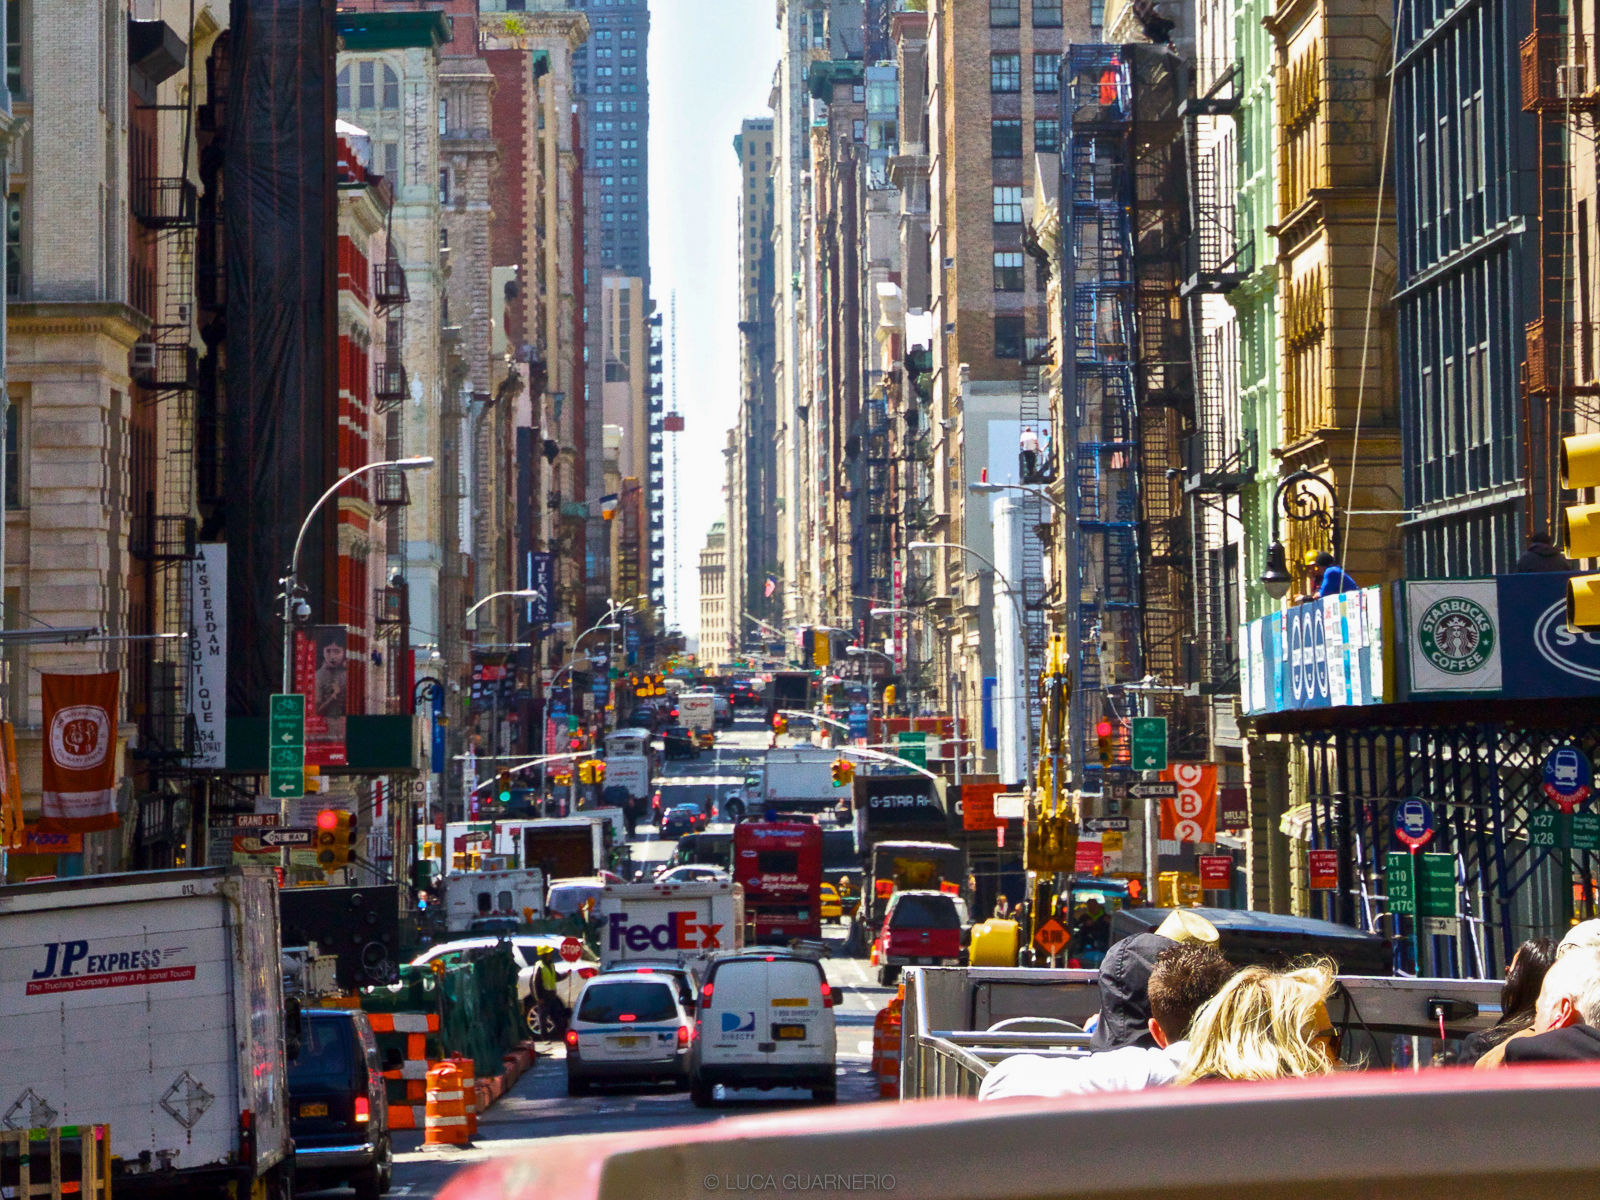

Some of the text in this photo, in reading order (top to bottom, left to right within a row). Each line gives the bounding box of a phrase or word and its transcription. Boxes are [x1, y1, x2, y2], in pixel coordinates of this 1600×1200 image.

[537, 561, 548, 615] JEANS
[196, 551, 220, 656] AMSTERDAM
[1423, 601, 1491, 633] STARBUCKS
[1431, 651, 1484, 671] COFFEE
[191, 628, 213, 723] BOUTIQUE
[1136, 785, 1173, 795] ONE WAY
[870, 795, 914, 807] G-STAR
[238, 817, 276, 826] GRAND ST
[1533, 815, 1554, 827] x27
[289, 833, 305, 841] WAY
[1533, 833, 1554, 844] x28
[1389, 856, 1399, 866] x1
[1390, 870, 1407, 882] x10
[1390, 885, 1407, 897] x12
[1390, 900, 1413, 912] x17C
[609, 911, 724, 951] FedEx
[562, 944, 581, 954] STOP
[32, 940, 161, 979] J.P. EXPRESS
[28, 983, 43, 992] The
[45, 980, 74, 990] Trucking
[75, 977, 110, 988] Company
[111, 975, 128, 984] With
[136, 971, 168, 981] Pesonal
[170, 969, 192, 979] Touch
[721, 1033, 755, 1041] DIRECTV
